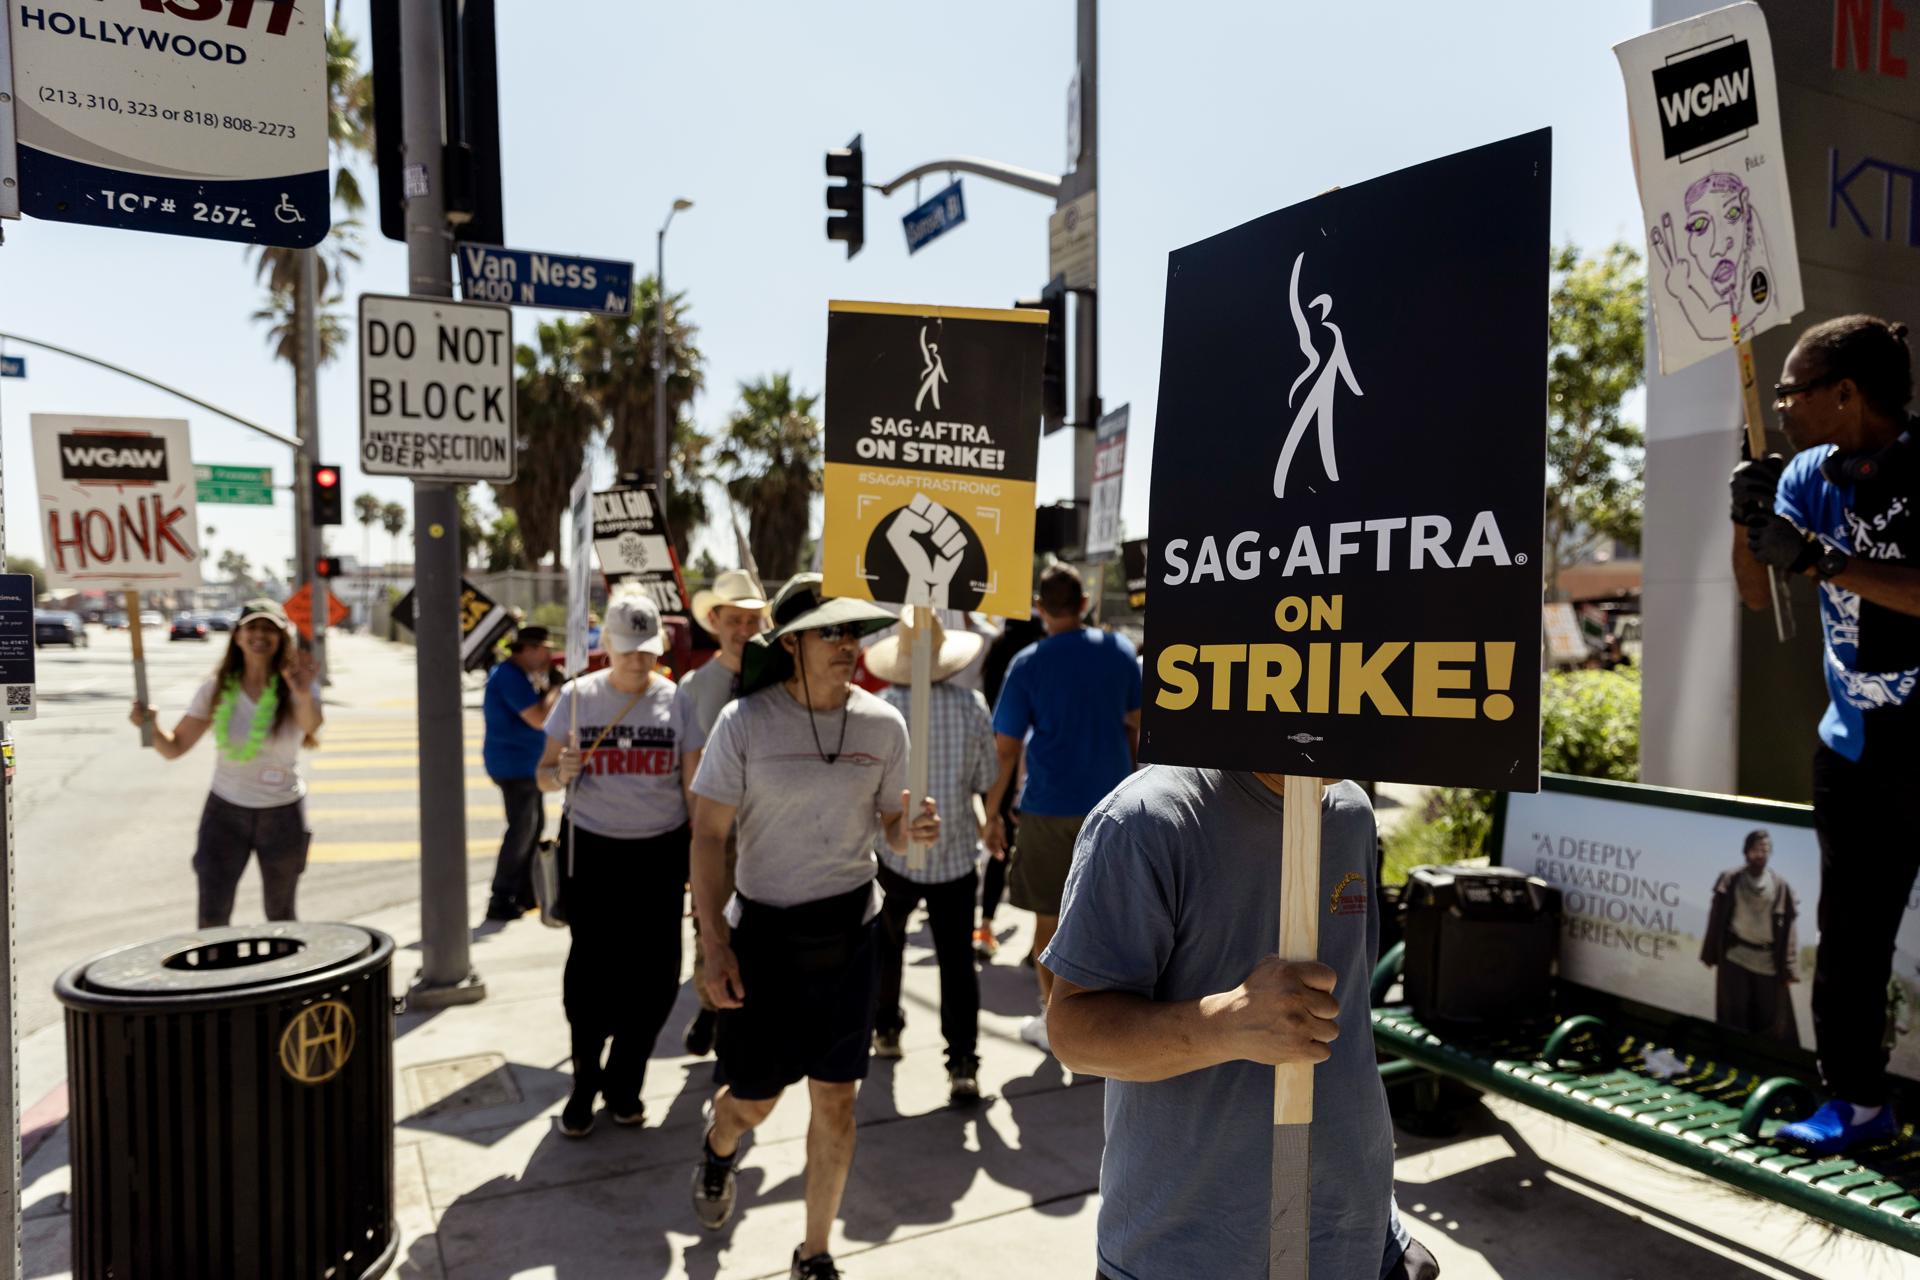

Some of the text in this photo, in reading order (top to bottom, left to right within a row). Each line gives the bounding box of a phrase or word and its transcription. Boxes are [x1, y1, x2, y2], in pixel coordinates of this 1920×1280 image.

[20, 5, 247, 65] HOLLYWOOD
[38, 85, 296, 139] (213, 310, 323 or 818) 808-2273
[1660, 67, 1750, 128] WGAW
[466, 248, 597, 290] Van Ness
[467, 278, 535, 303] 1400 N
[368, 320, 505, 365] DO NOT
[369, 378, 505, 423] BLOCK
[64, 447, 163, 468] WGAW
[856, 438, 1005, 470] ON STRIKE!
[858, 472, 1001, 497] #SAGAFTRASTRONG
[49, 494, 196, 574] HONK
[1274, 594, 1343, 632] ON
[1155, 641, 1516, 721] STRIKE!
[1558, 836, 1642, 871] DEEPLY
[1535, 857, 1681, 907] REWARDING
